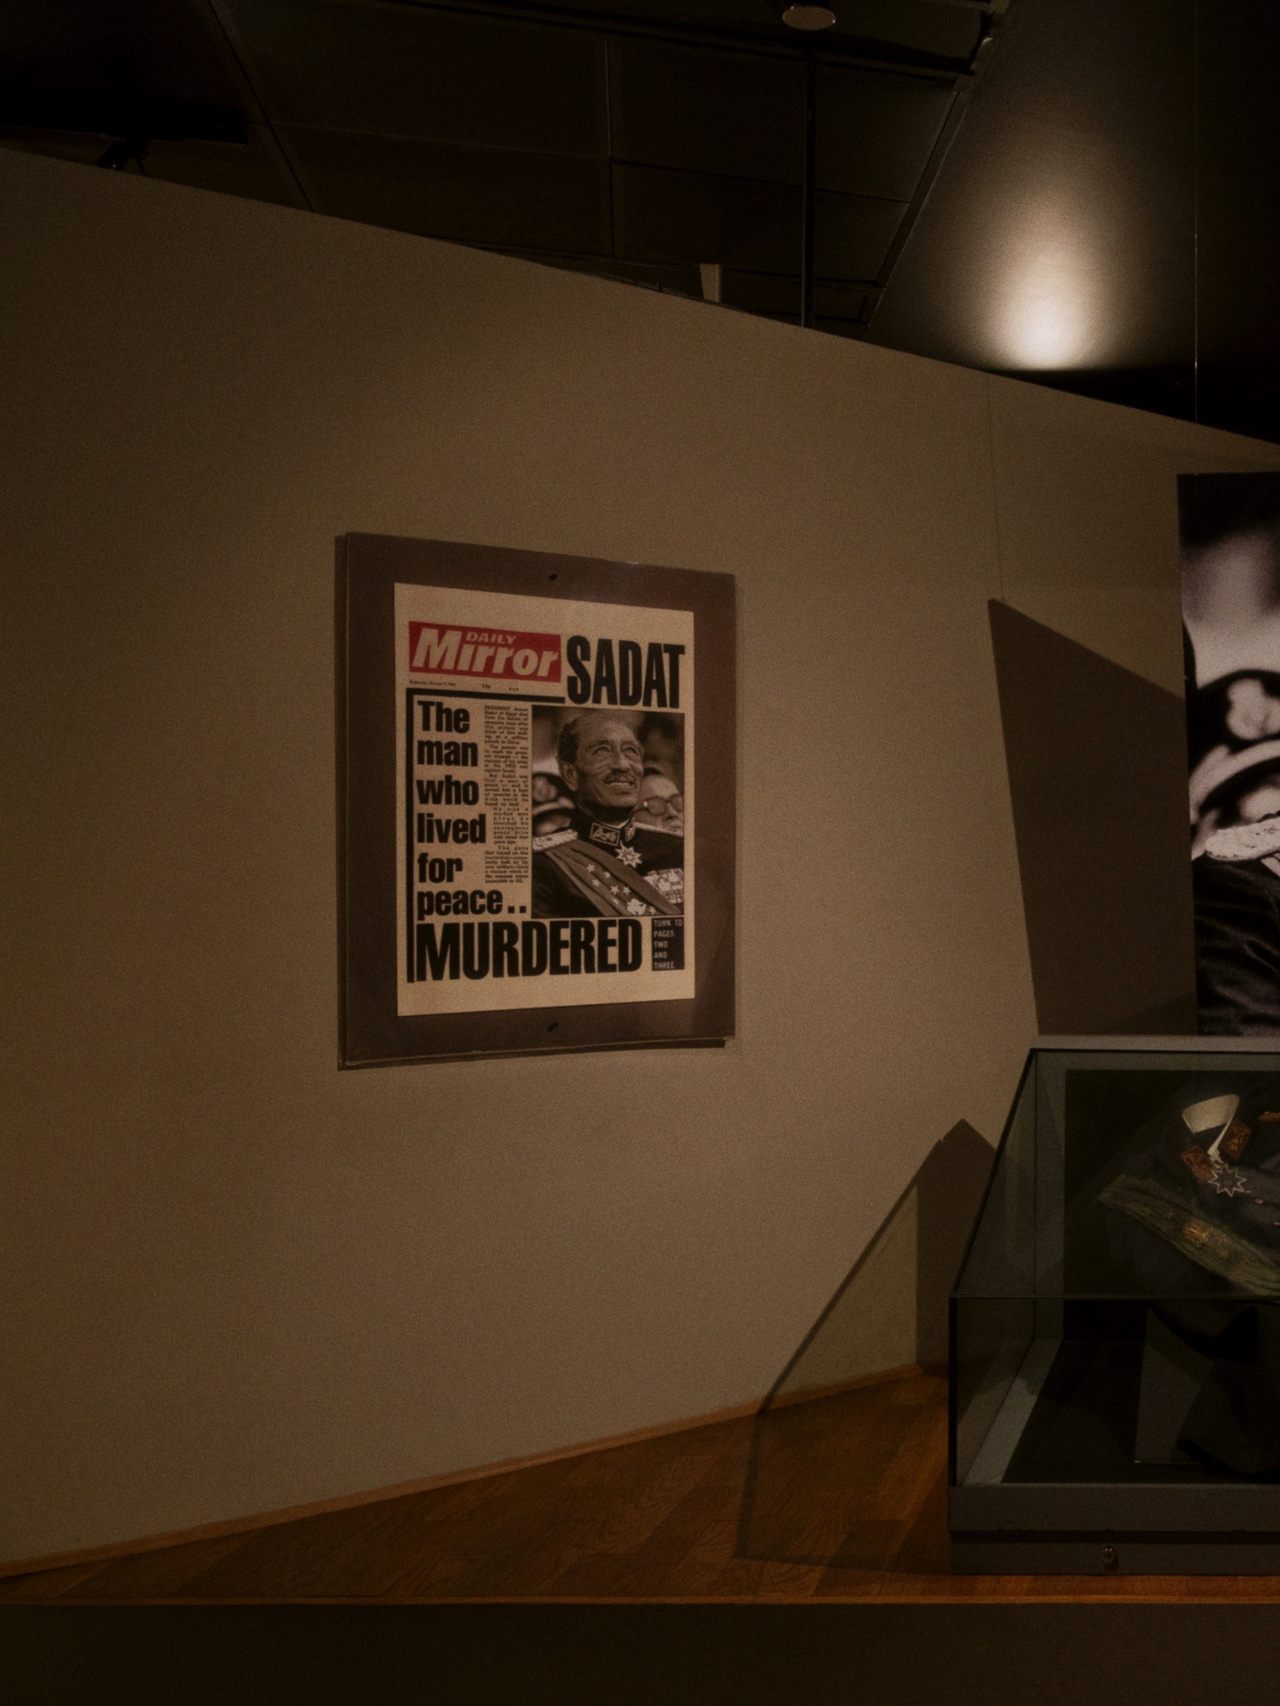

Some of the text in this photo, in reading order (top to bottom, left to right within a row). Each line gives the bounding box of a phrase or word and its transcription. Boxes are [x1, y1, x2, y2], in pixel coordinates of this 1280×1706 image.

[412, 626, 560, 678] Mirror
[466, 631, 518, 645] DAILY
[566, 635, 685, 710] SADAT
[416, 700, 470, 734] The
[417, 740, 479, 767] man
[416, 775, 480, 805] who
[417, 812, 487, 844] lived
[417, 853, 463, 884] for
[653, 919, 683, 928] TURN TO
[653, 930, 675, 938] PAGES
[416, 918, 643, 982] MURDERED
[653, 940, 669, 949] TWO
[653, 951, 668, 959] AND
[653, 961, 675, 970] THREE
